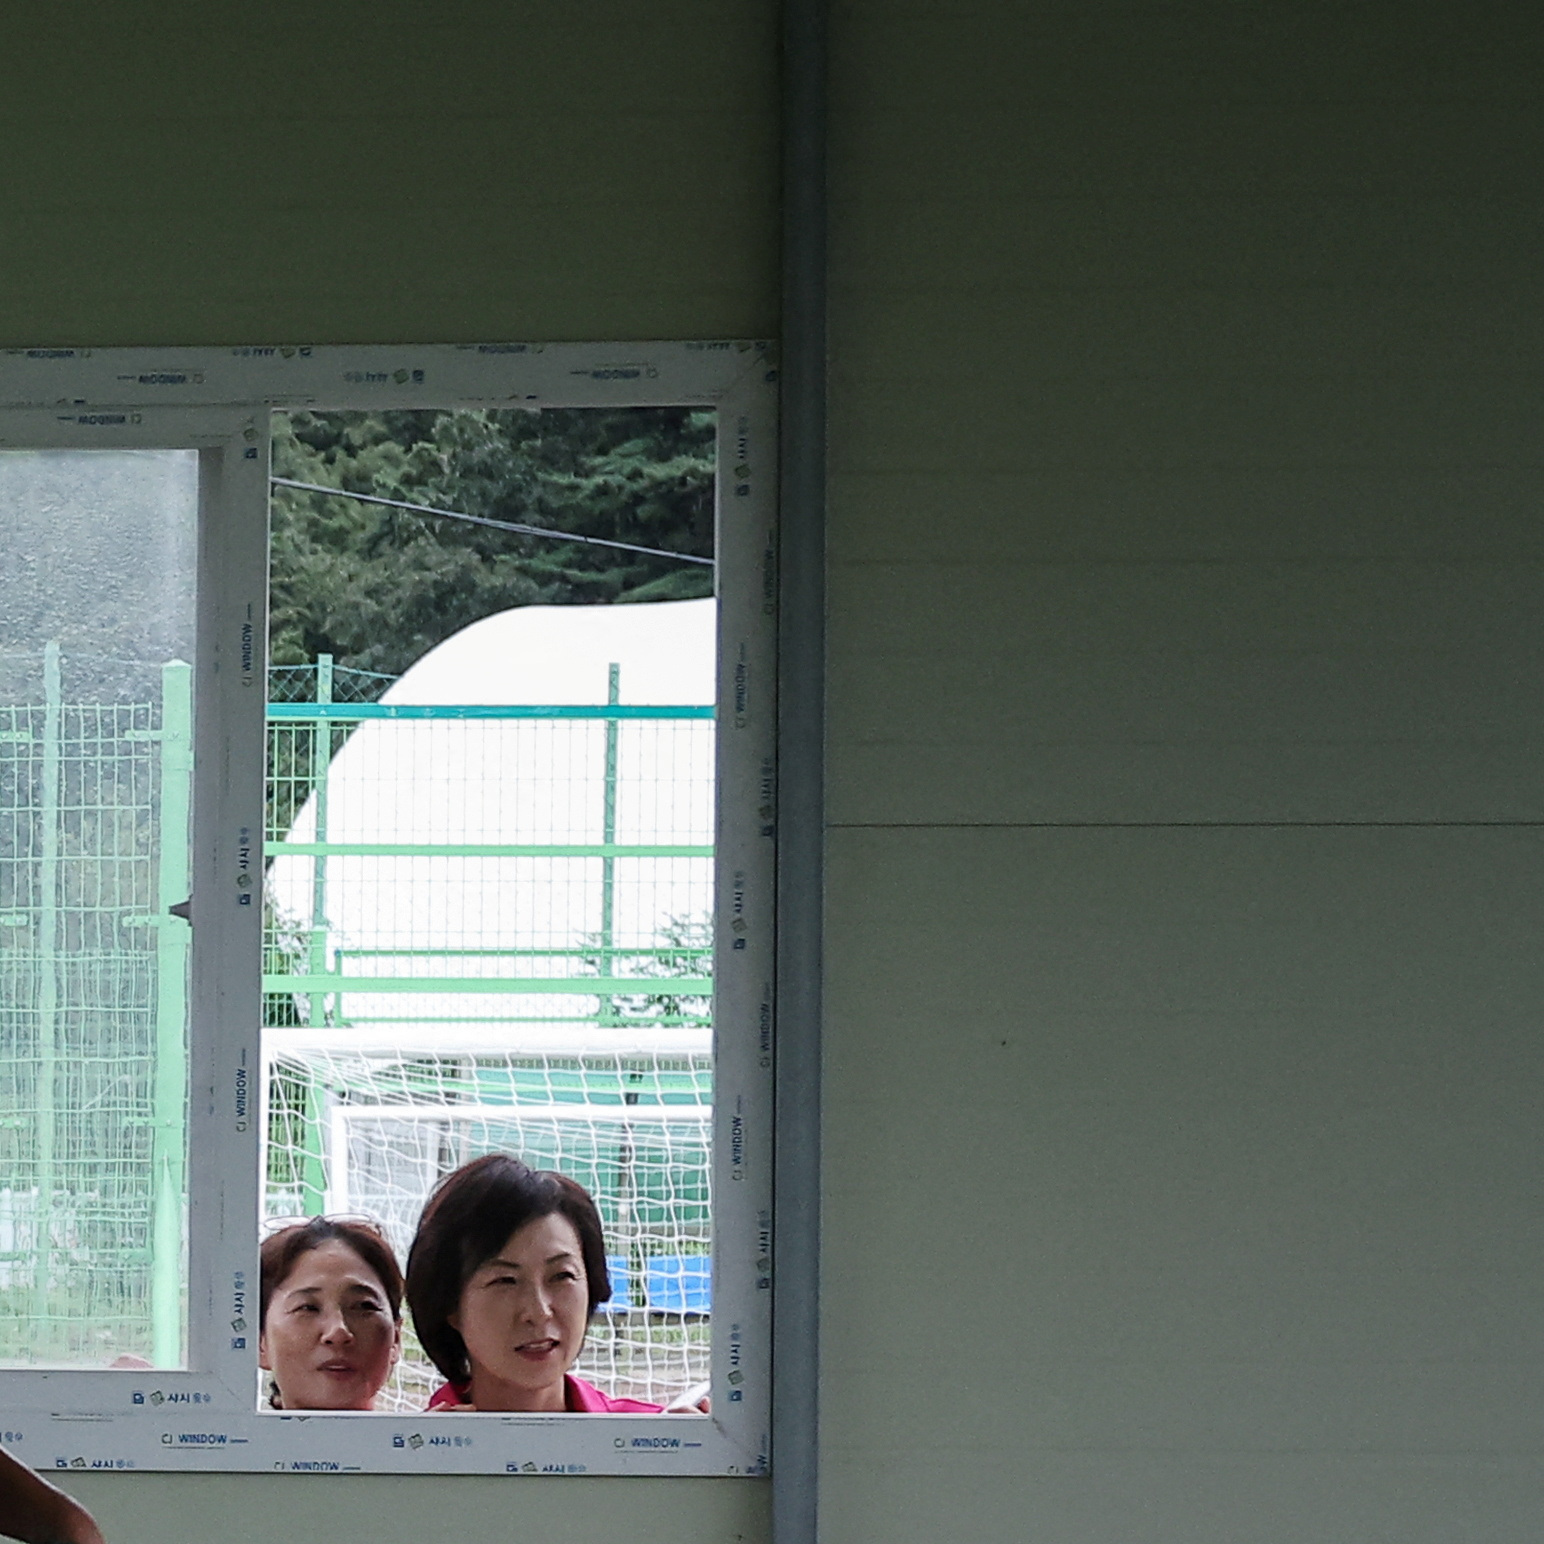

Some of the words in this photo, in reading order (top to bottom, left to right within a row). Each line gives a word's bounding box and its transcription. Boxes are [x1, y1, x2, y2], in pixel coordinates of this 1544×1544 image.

[237, 1068, 246, 1115] WINDOW
[179, 1434, 227, 1444] WINDOW
[631, 1438, 680, 1447] WINDOW
